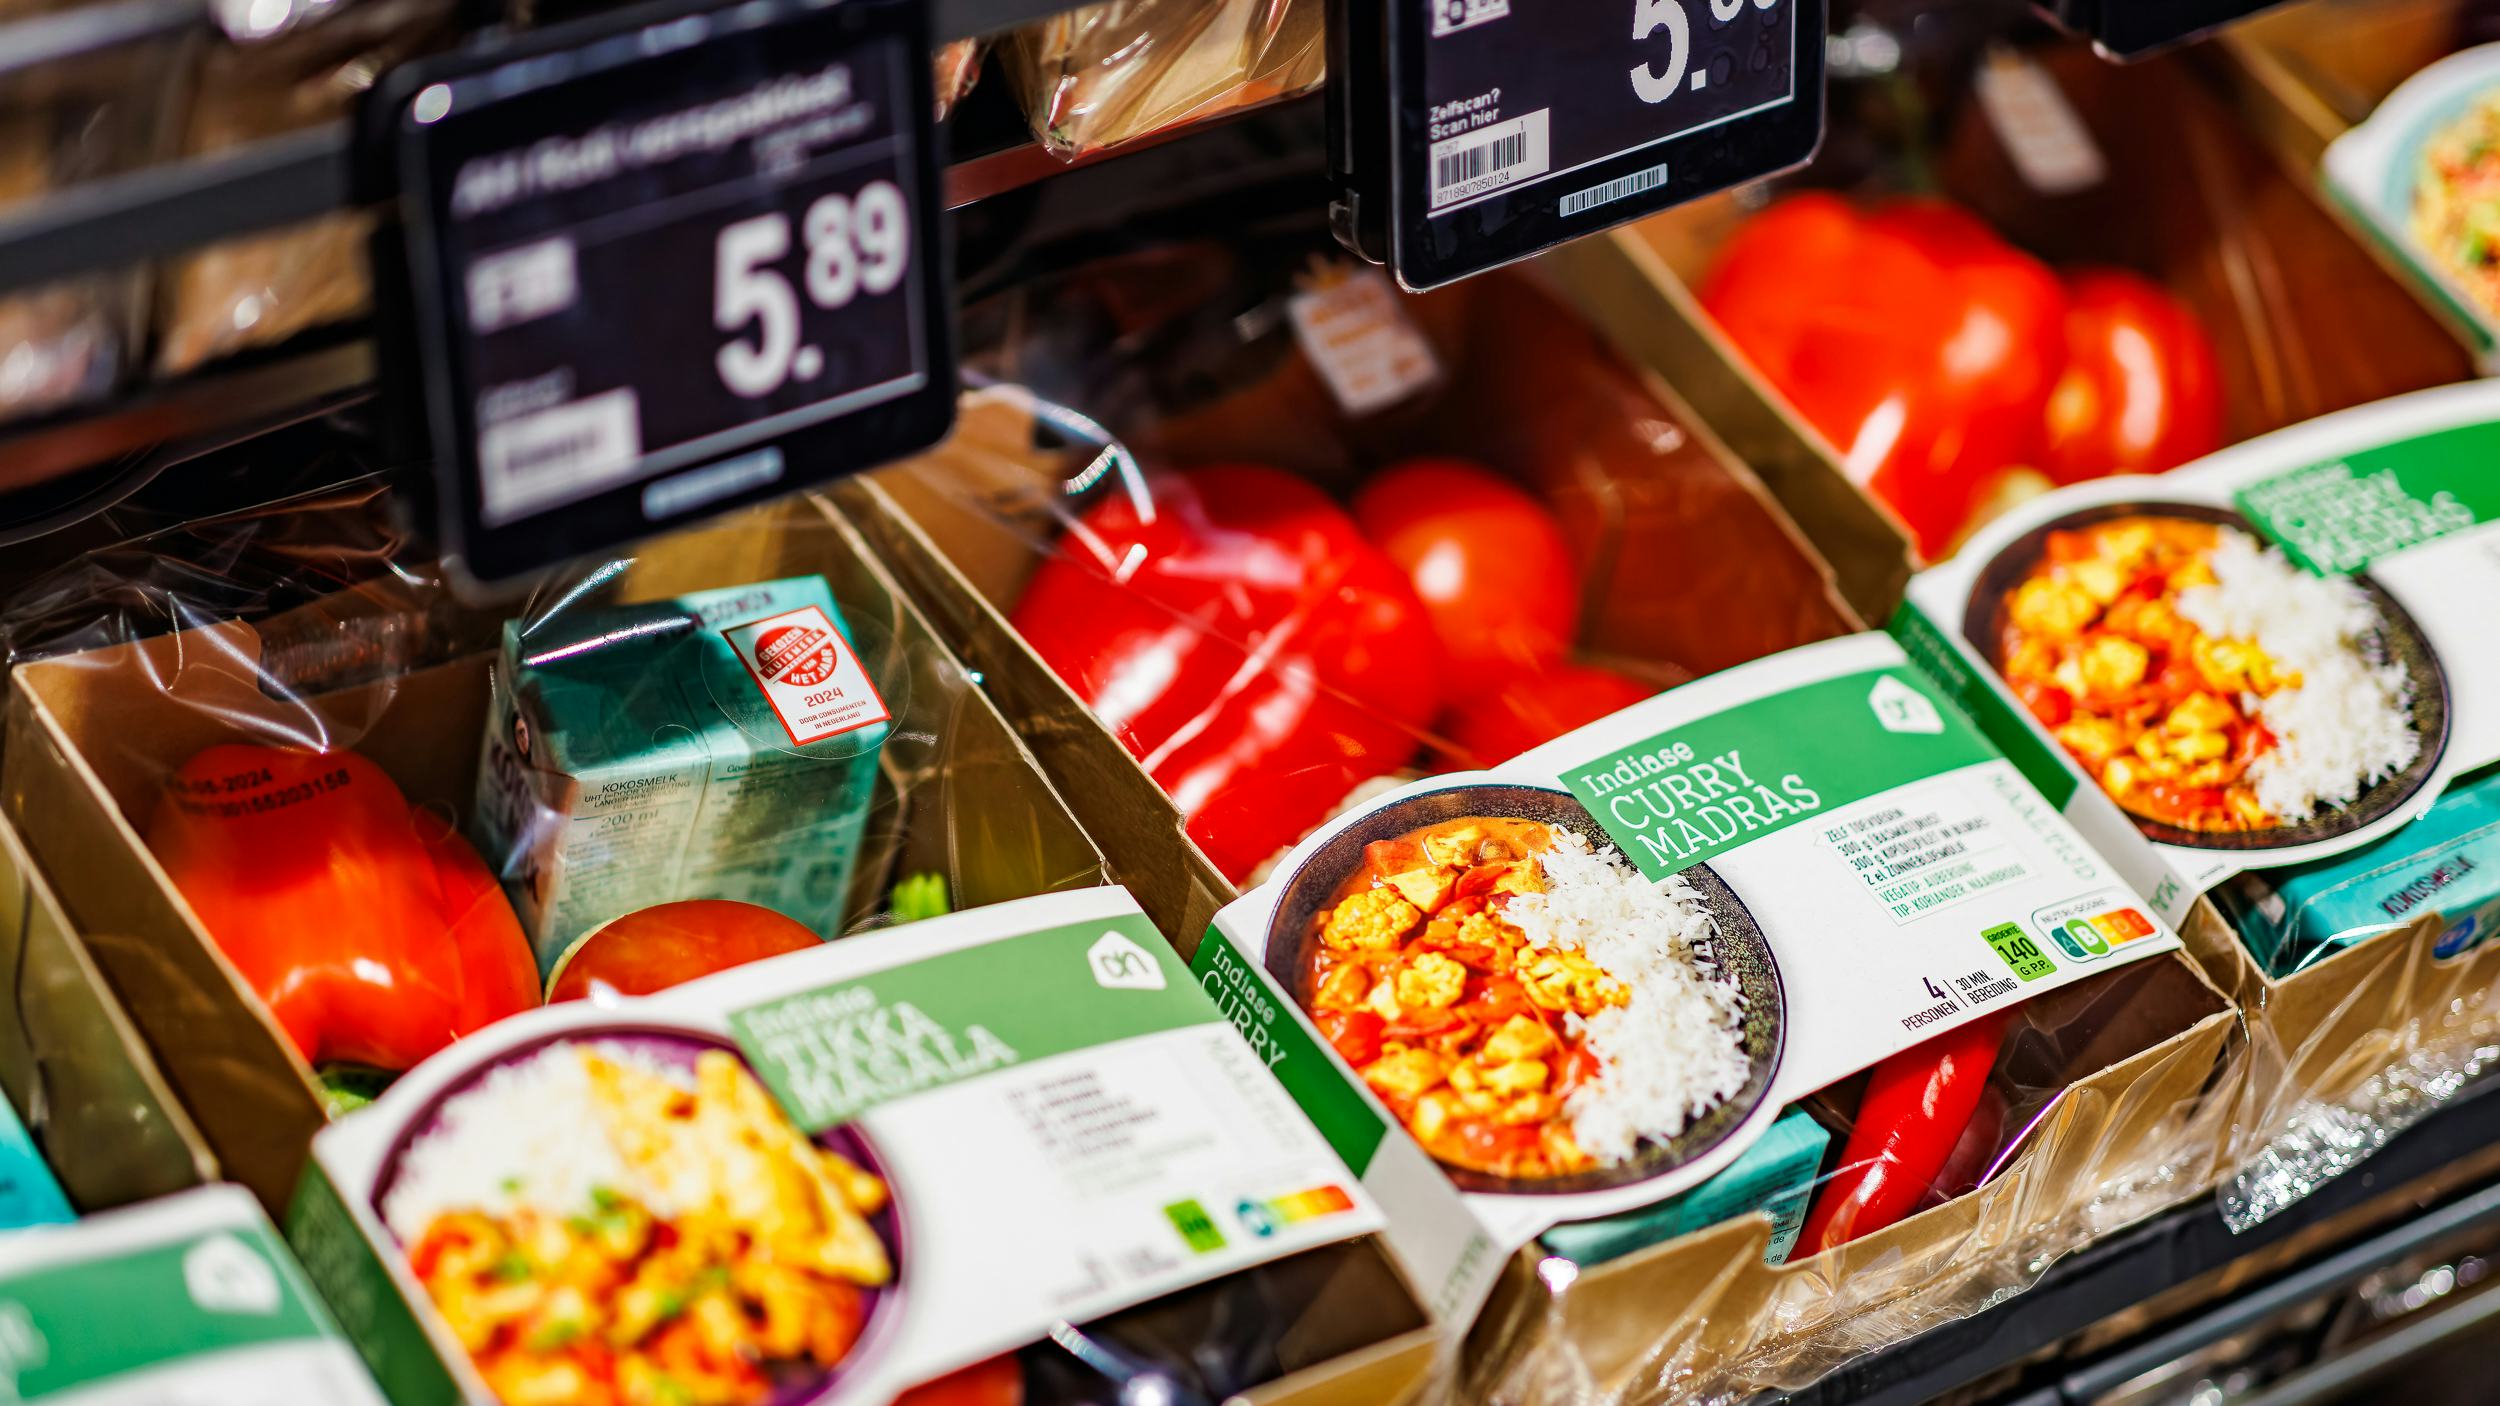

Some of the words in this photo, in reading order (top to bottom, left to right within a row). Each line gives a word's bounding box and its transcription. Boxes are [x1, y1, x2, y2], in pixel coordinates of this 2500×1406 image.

[1429, 88, 1501, 122] Zelfscan?
[1430, 117, 1469, 139] Scan
[1471, 107, 1499, 127] hier
[1437, 171, 1510, 203] 8718907850124
[759, 626, 804, 660] GEKOZEN
[765, 630, 823, 675] HUISMERK
[791, 671, 818, 685] HET
[817, 648, 834, 677] JAAR
[804, 687, 844, 708] 2024
[798, 715, 817, 725] DOOR
[818, 699, 867, 719] CONSUMENTEN
[814, 722, 823, 730] IN
[822, 711, 861, 727] NEDERLAND
[1580, 741, 1695, 797] Indiase
[602, 774, 678, 794] KOKOSMELK
[1609, 750, 1755, 829] CURRY
[584, 794, 603, 803] UHT
[600, 812, 633, 829] 200
[638, 808, 659, 820] ml
[1635, 774, 1821, 867] MADRAS
[1825, 825, 1849, 843] ZELF
[1838, 841, 1861, 857] 300
[1850, 854, 1874, 871] 300
[1874, 854, 1885, 865] g
[1863, 873, 1875, 886] 2
[1875, 867, 1888, 882] el
[1892, 903, 1916, 918] TIP:
[1987, 924, 2020, 942] GROENTE
[2073, 927, 2099, 947] B
[1997, 936, 2040, 966] 140
[2020, 966, 2030, 976] G
[2030, 959, 2050, 973] P.P.
[1212, 944, 1276, 1025] Indiase
[1922, 976, 1947, 1000] 4
[1955, 976, 1972, 991] 30
[1971, 968, 1994, 987] MIN.
[1966, 977, 2018, 1005] BEREIDING
[1201, 969, 1287, 1068] CURRY
[1901, 1000, 1960, 1031] PERSONEN
[1773, 1234, 1784, 1245] de
[1770, 1252, 1782, 1263] de
